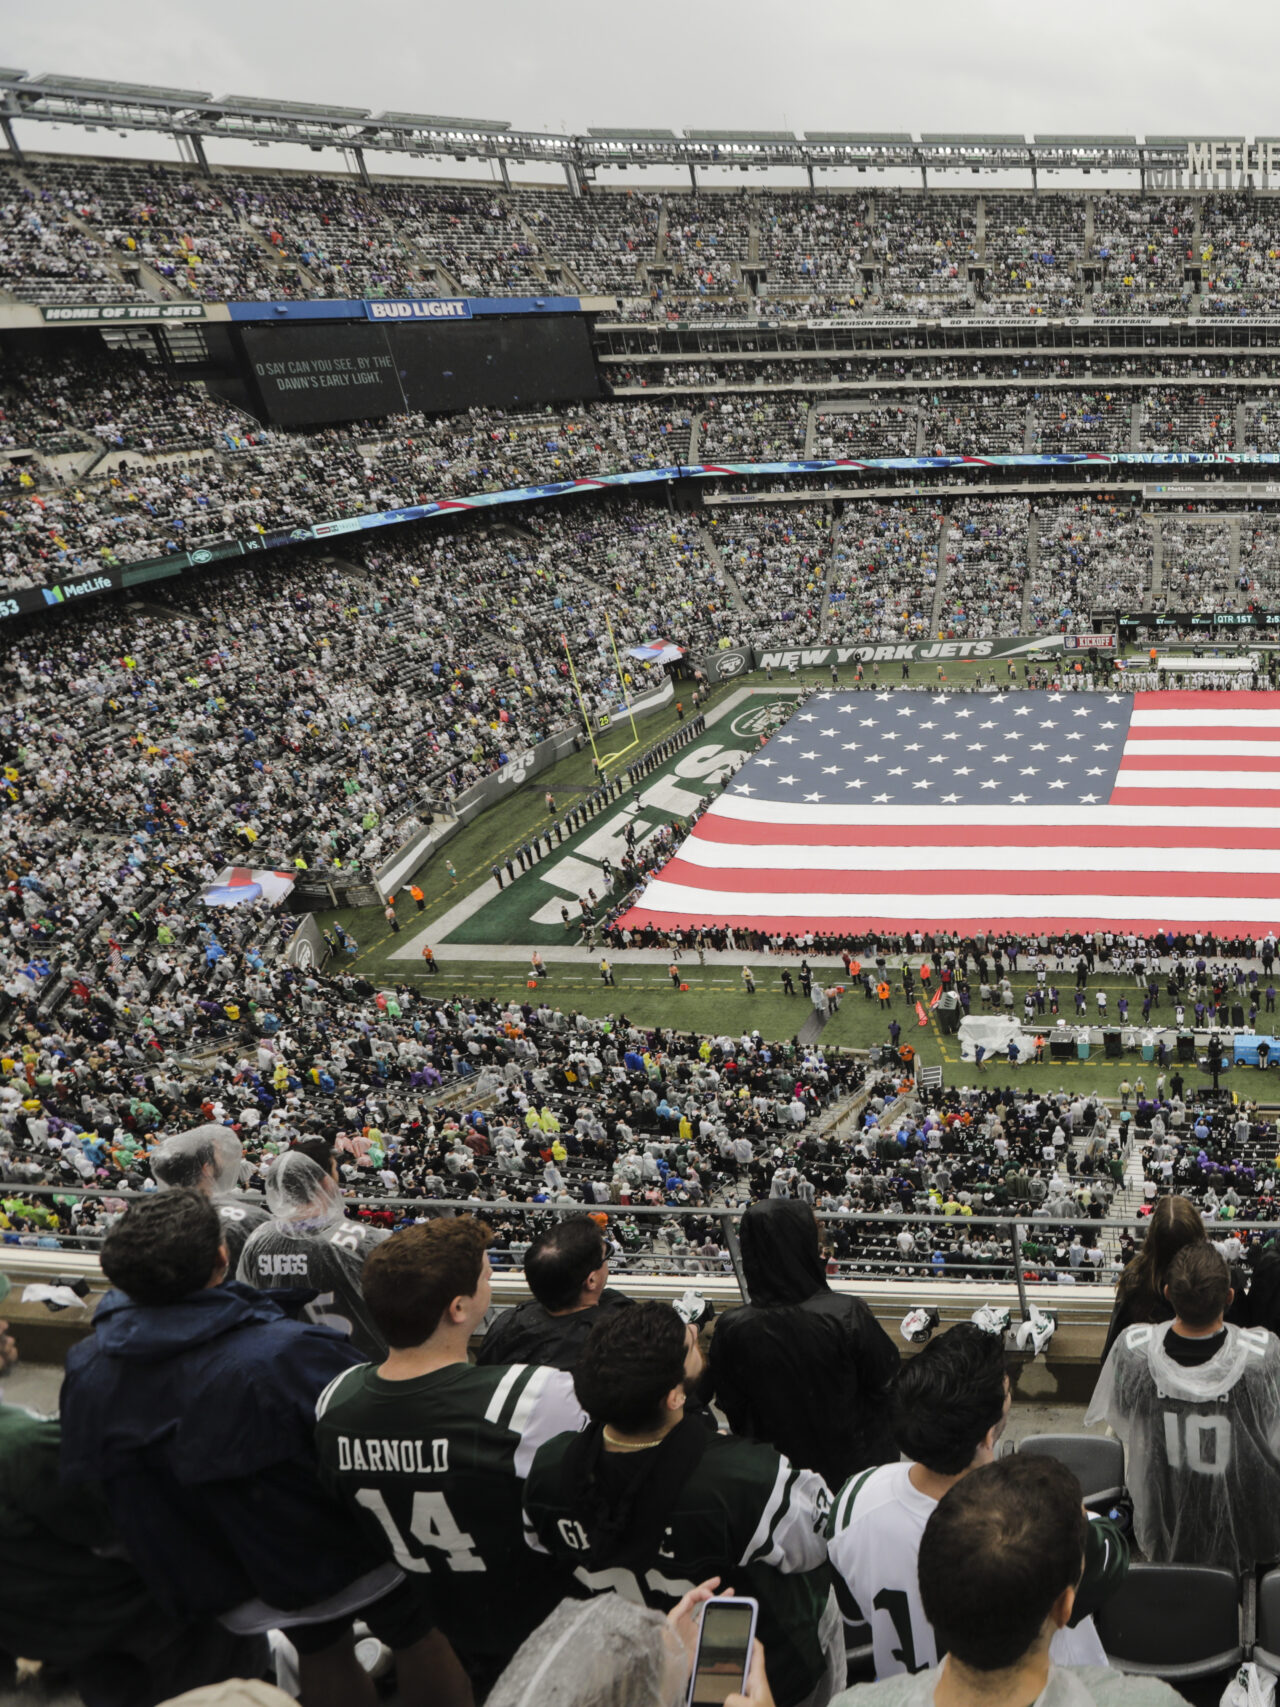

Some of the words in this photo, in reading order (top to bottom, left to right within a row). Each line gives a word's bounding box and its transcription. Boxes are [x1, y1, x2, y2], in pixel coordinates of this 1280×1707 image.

[46, 308, 100, 320] HOME
[102, 308, 126, 318] OF
[127, 307, 160, 318] THE
[162, 306, 202, 317] JETS
[370, 302, 412, 318] BUD
[412, 301, 465, 317] LIGHT
[726, 321, 758, 329] HONOR
[256, 363, 265, 376] O
[265, 362, 286, 375] SAY
[288, 361, 311, 374] CAN
[311, 360, 333, 372] YOU
[335, 358, 357, 371] SEE,
[357, 357, 370, 369] BY
[372, 356, 393, 367] THE
[276, 376, 319, 391] DAWN'S
[320, 374, 350, 387] EARLY
[352, 371, 383, 384] LIGHT,
[1111, 455, 1119, 464] O
[1127, 455, 1152, 464] SAY
[1161, 454, 1190, 463] CAN
[1199, 454, 1225, 463] YOU
[246, 539, 261, 551] VS.
[63, 576, 113, 598] MetLife
[1217, 616, 1234, 624] QTR
[1236, 615, 1252, 623] 1ST
[1079, 636, 1110, 647] KICKOFF
[760, 649, 838, 668] NEW
[835, 644, 917, 663] YORK
[920, 641, 994, 658] JETS
[599, 715, 609, 727] 25
[498, 751, 535, 784] JETS
[529, 744, 752, 924] JETS
[220, 1206, 247, 1221] 8
[330, 1221, 367, 1252] 55
[258, 1253, 308, 1276] SUGGS
[1163, 1410, 1232, 1476] 10
[337, 1436, 449, 1474] DARNOLD
[355, 1487, 487, 1574] 14
